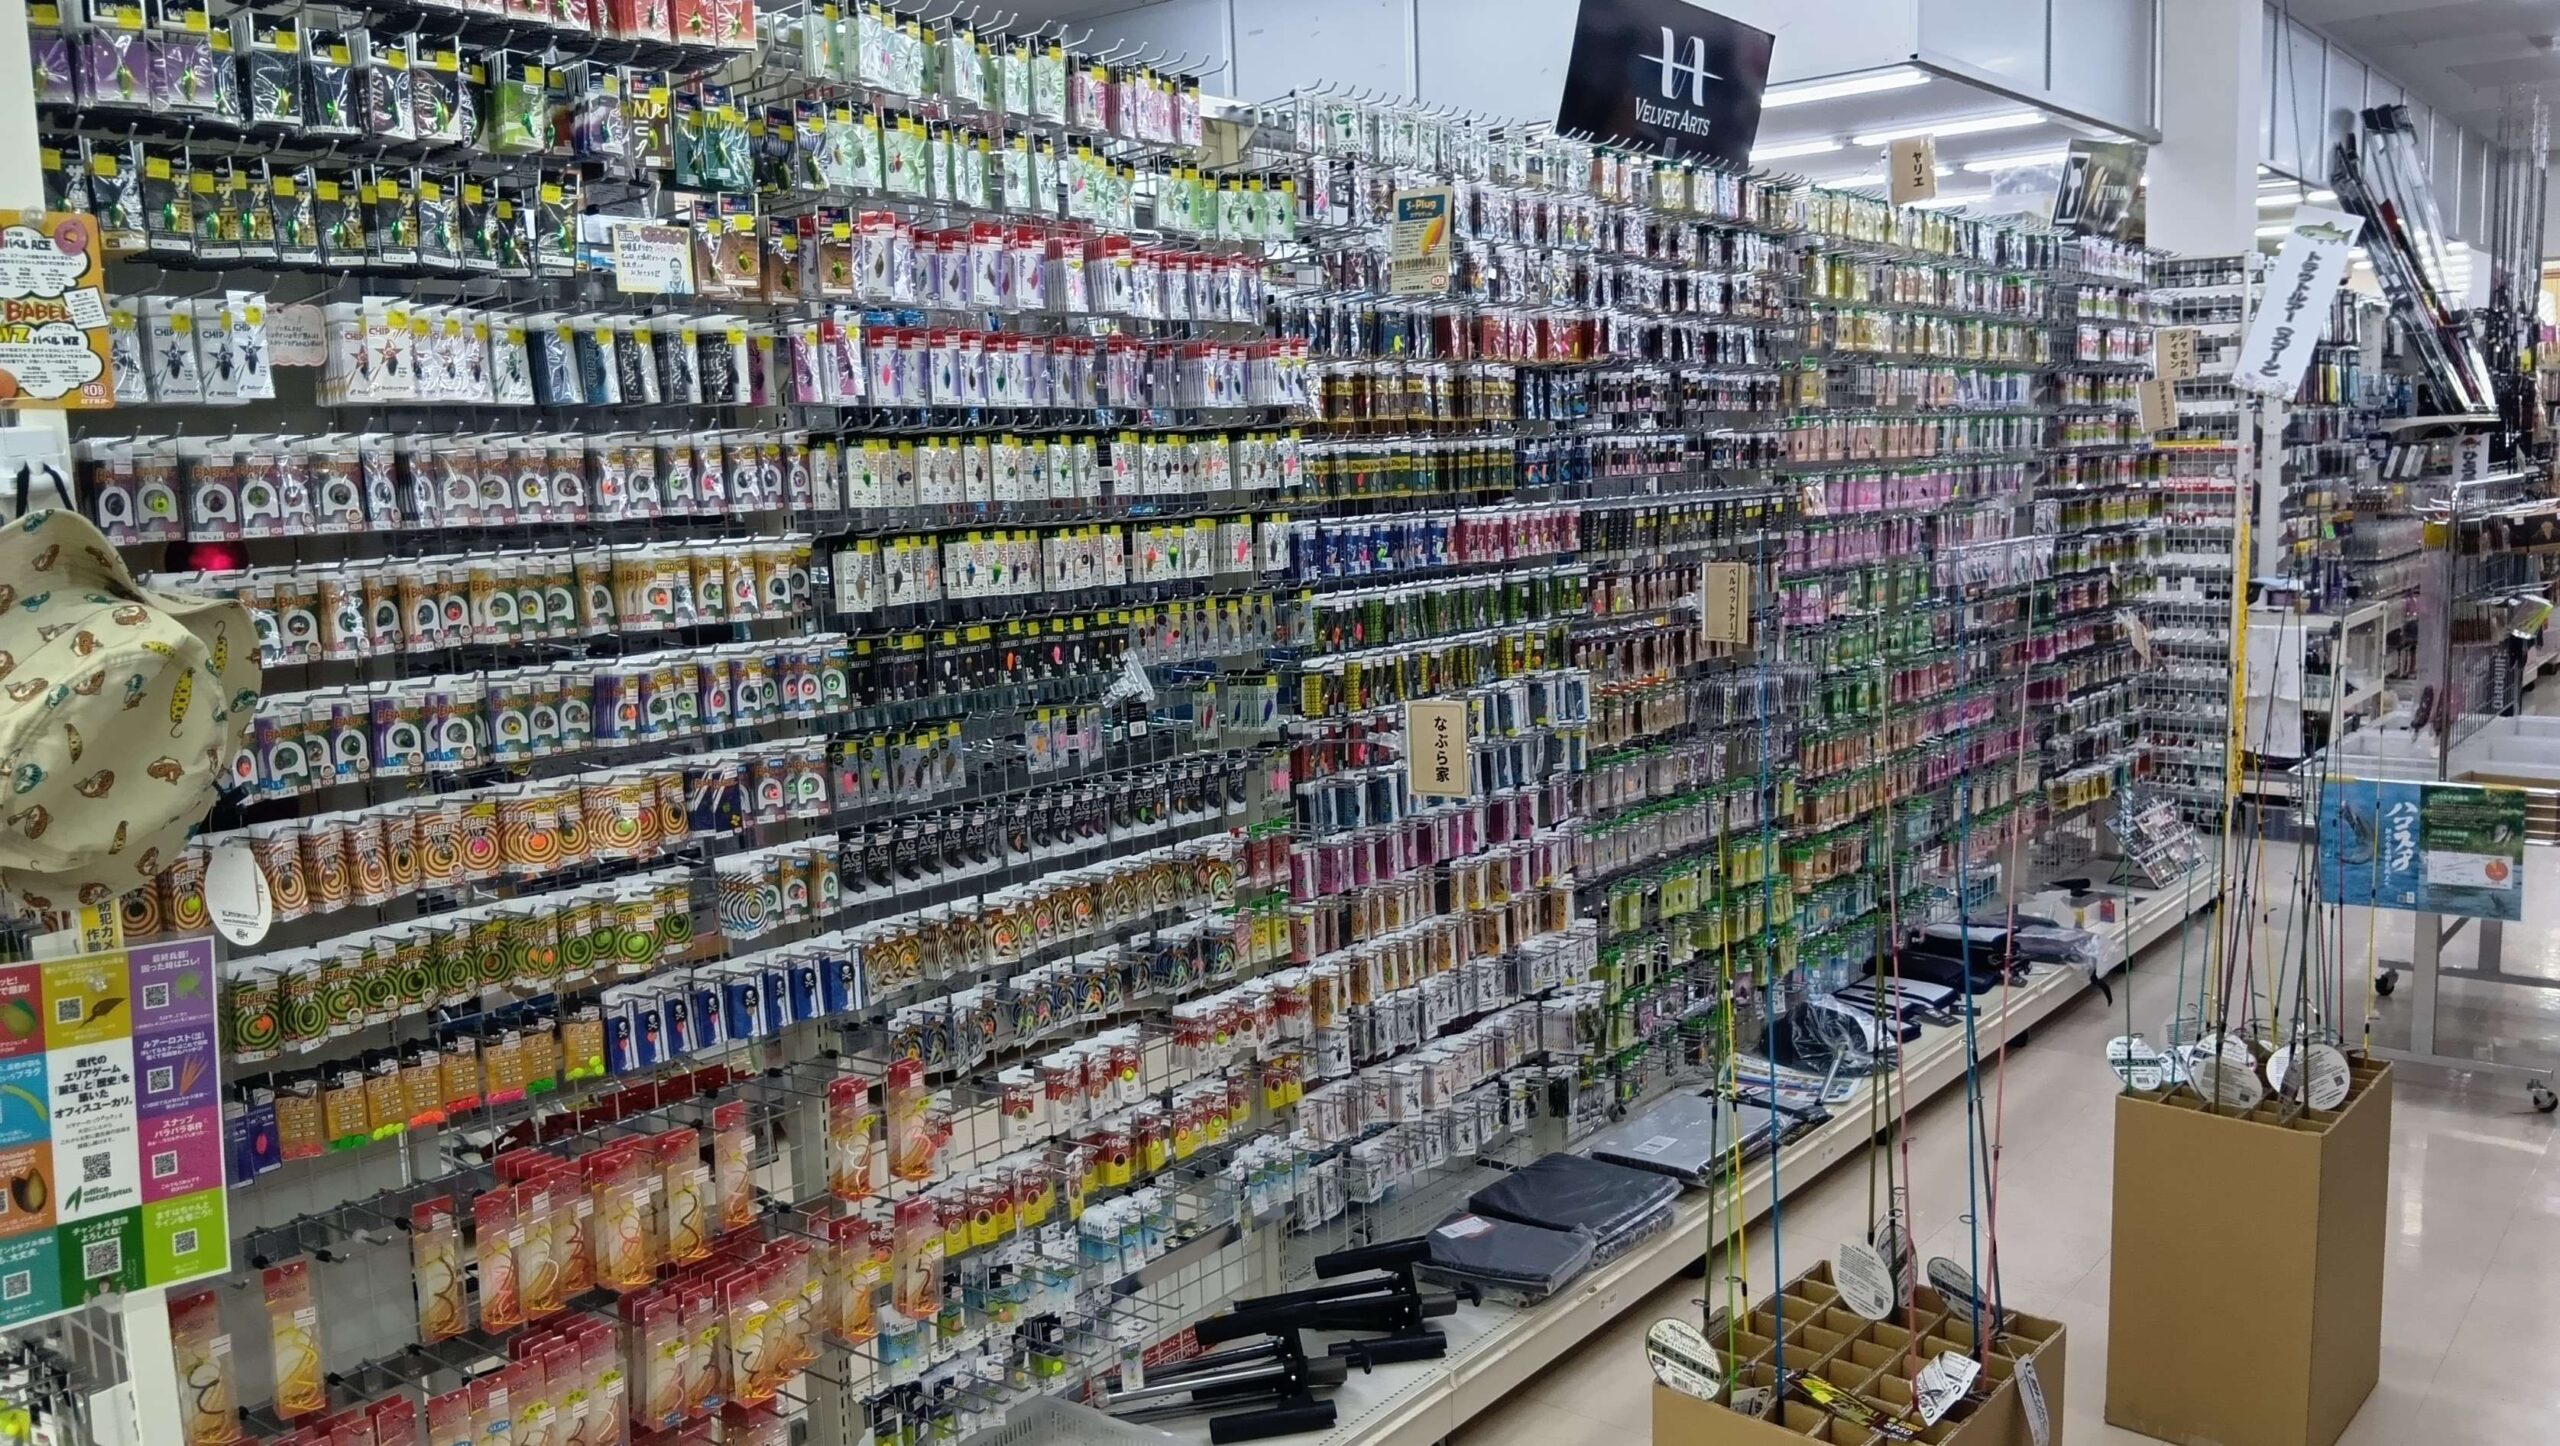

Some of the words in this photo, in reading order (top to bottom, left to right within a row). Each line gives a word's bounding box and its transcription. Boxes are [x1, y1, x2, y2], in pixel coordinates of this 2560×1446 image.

[1635, 96, 1680, 128] VELVET
[1678, 109, 1712, 137] ARTS
[1912, 152, 1925, 187] ヤリエ
[1406, 199, 1437, 211] S-Plug
[31, 239, 52, 251] ACE
[5, 299, 77, 322] BABEL
[62, 336, 80, 345] WZ
[2169, 333, 2179, 369] ティモン
[83, 384, 105, 396] ROB
[1434, 715, 1450, 782] なぶら家
[140, 957, 201, 974] 困った時はコレ!
[76, 1055, 107, 1068] 現代の
[63, 1064, 121, 1082] エリアゲーム
[78, 1090, 109, 1103] 築いた
[54, 1096, 134, 1120] オフィスユーカリ。
[162, 1115, 195, 1129] スナップ
[83, 1185, 110, 1197] office
[84, 1186, 134, 1204] eucalyptus
[72, 1215, 130, 1237] チャンネル登録
[80, 1226, 123, 1244] よろしくね!
